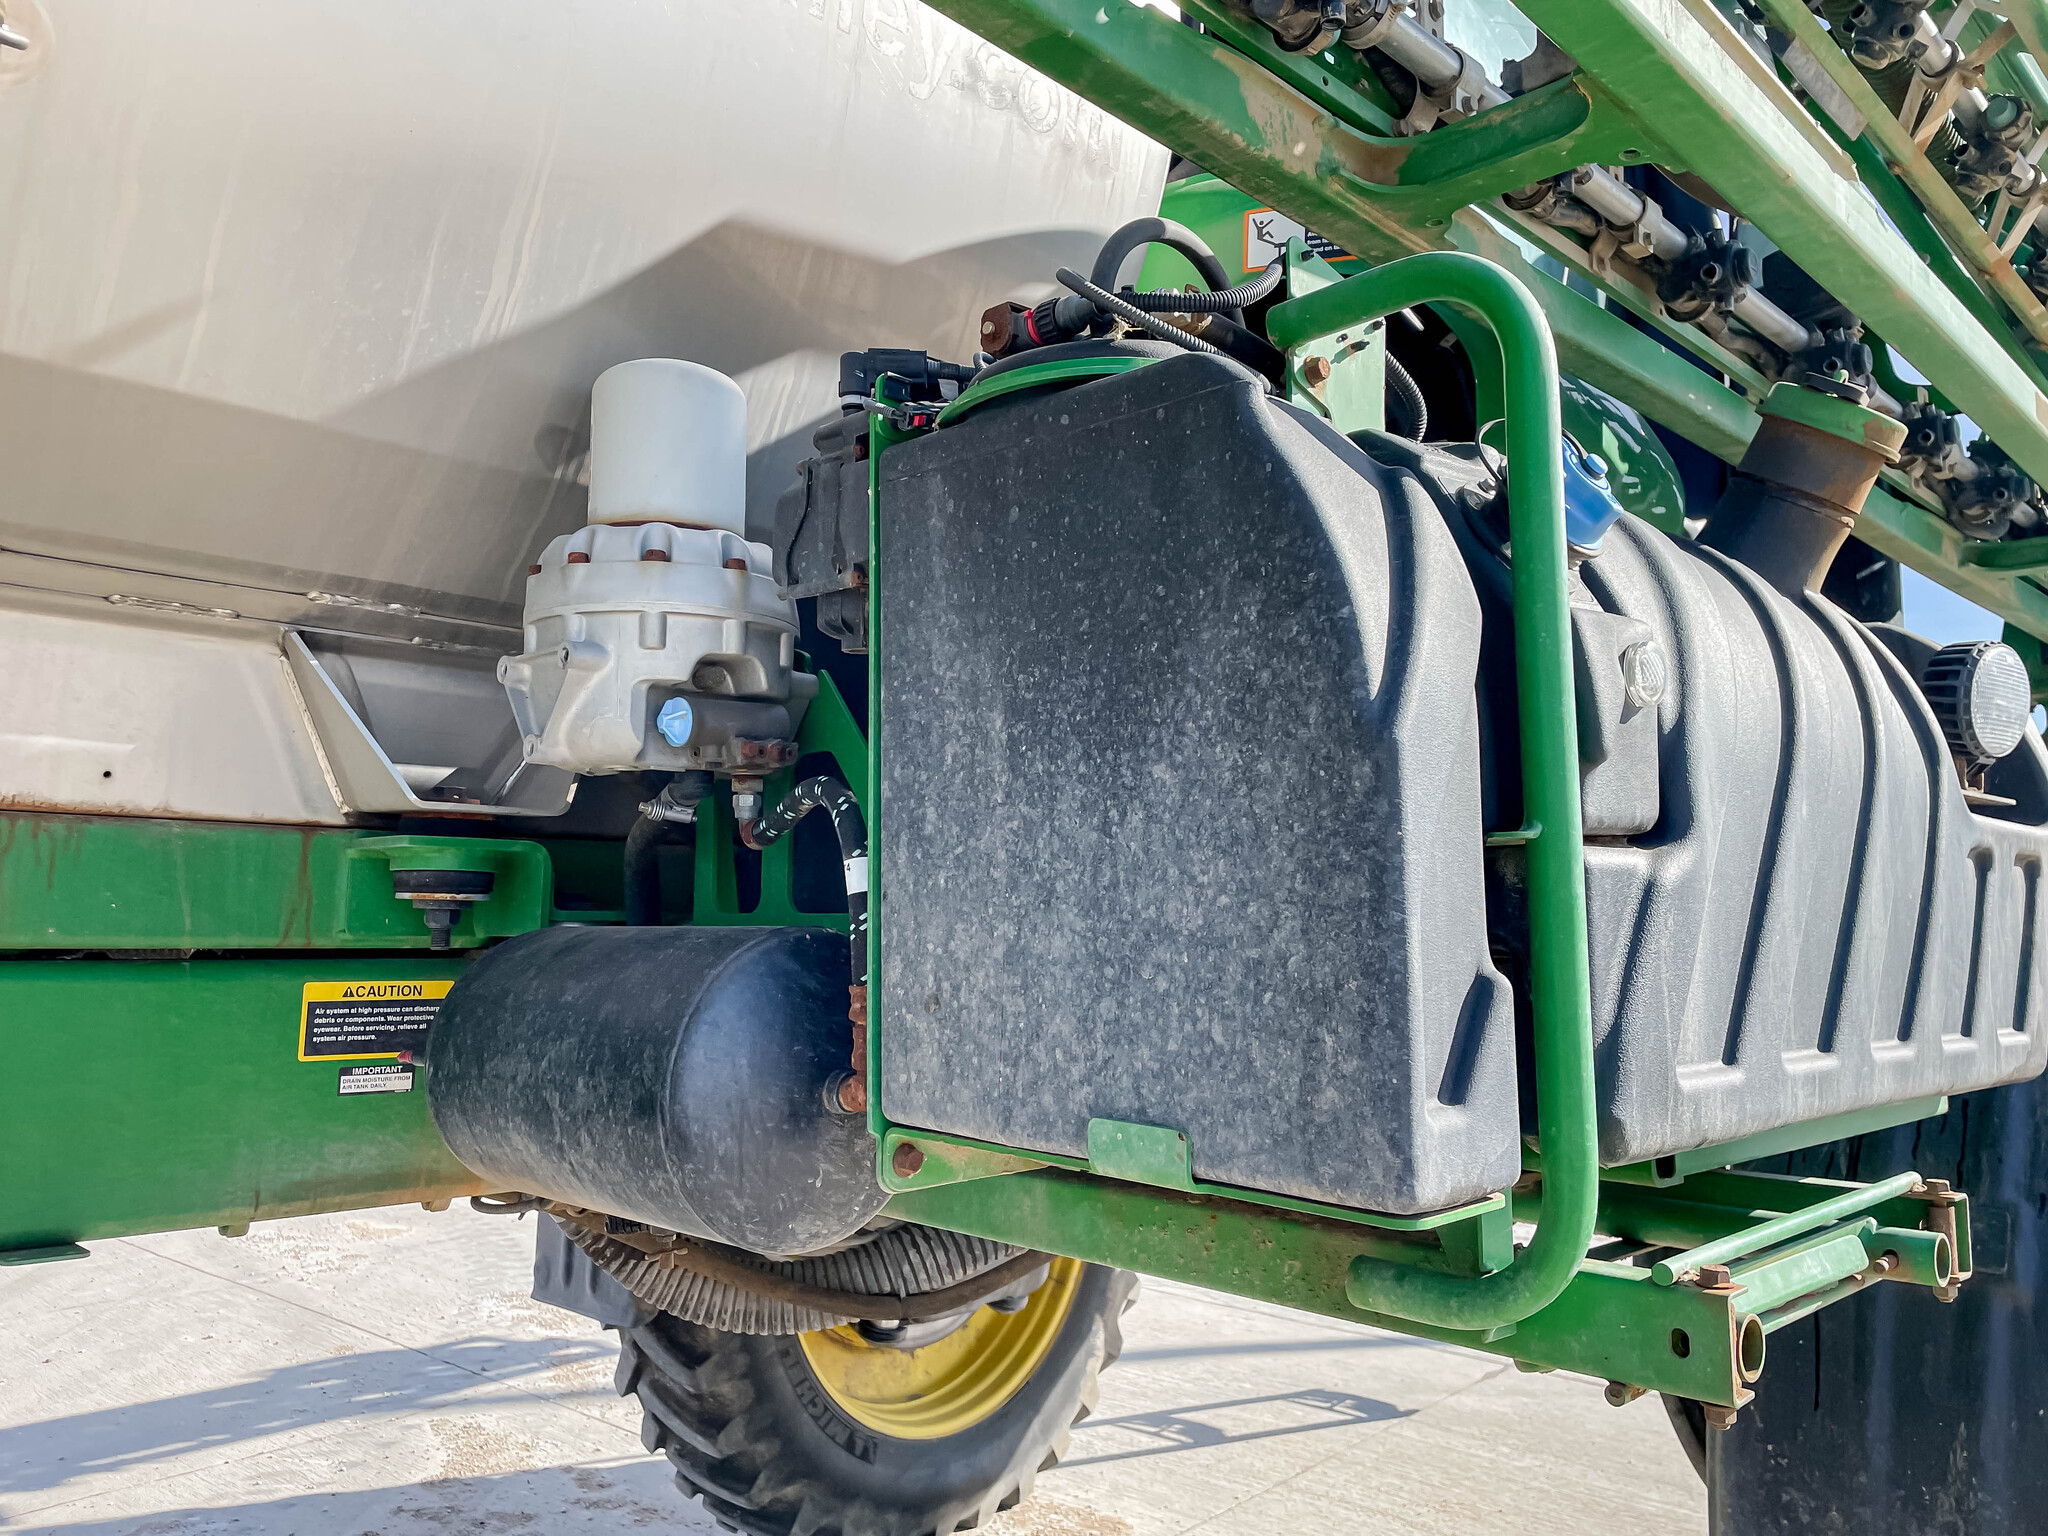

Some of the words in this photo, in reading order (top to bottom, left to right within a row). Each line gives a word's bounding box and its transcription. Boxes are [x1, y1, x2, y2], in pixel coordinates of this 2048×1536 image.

[355, 985, 423, 998] CAUTION
[326, 1008, 349, 1016] system
[358, 1007, 372, 1015] high
[345, 1016, 386, 1024] components.
[404, 1014, 434, 1022] protective
[313, 1026, 341, 1034] eyewear.
[347, 1034, 377, 1042] pressure.
[352, 1065, 403, 1075] IMPORTANT
